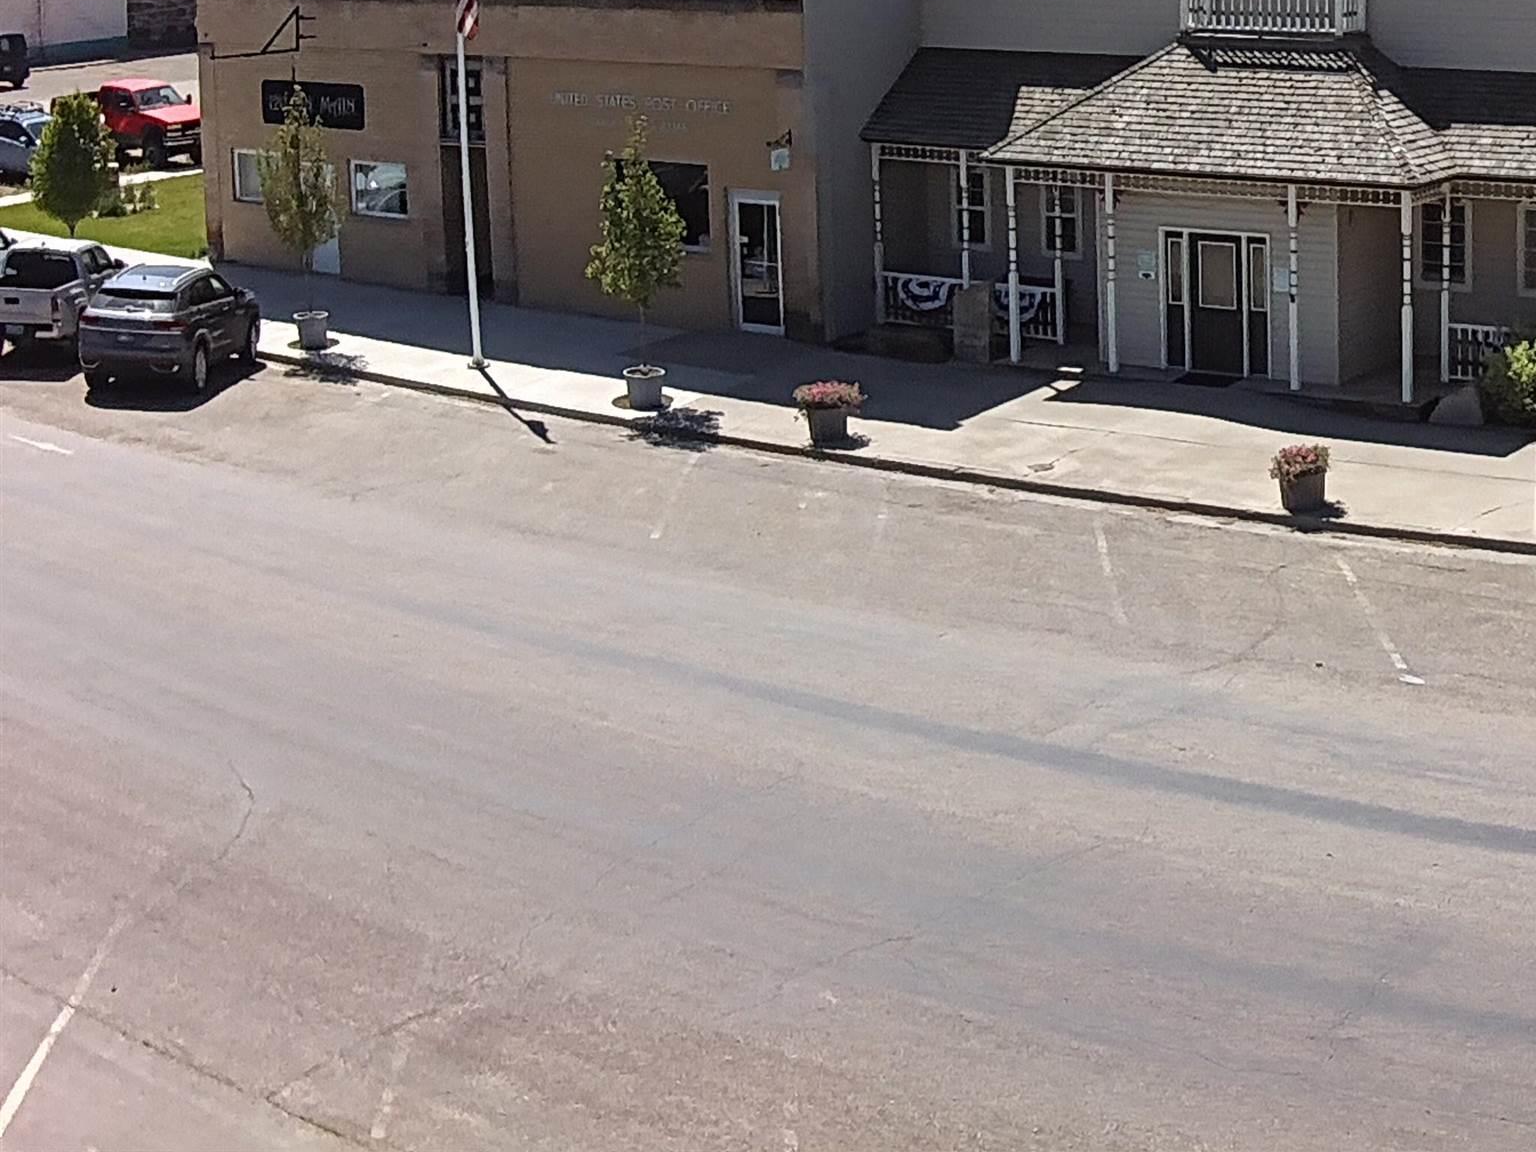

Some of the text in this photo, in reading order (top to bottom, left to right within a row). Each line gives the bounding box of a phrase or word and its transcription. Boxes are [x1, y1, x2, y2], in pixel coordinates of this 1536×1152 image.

[551, 92, 731, 115] UNITED STATES POST OFFICE
